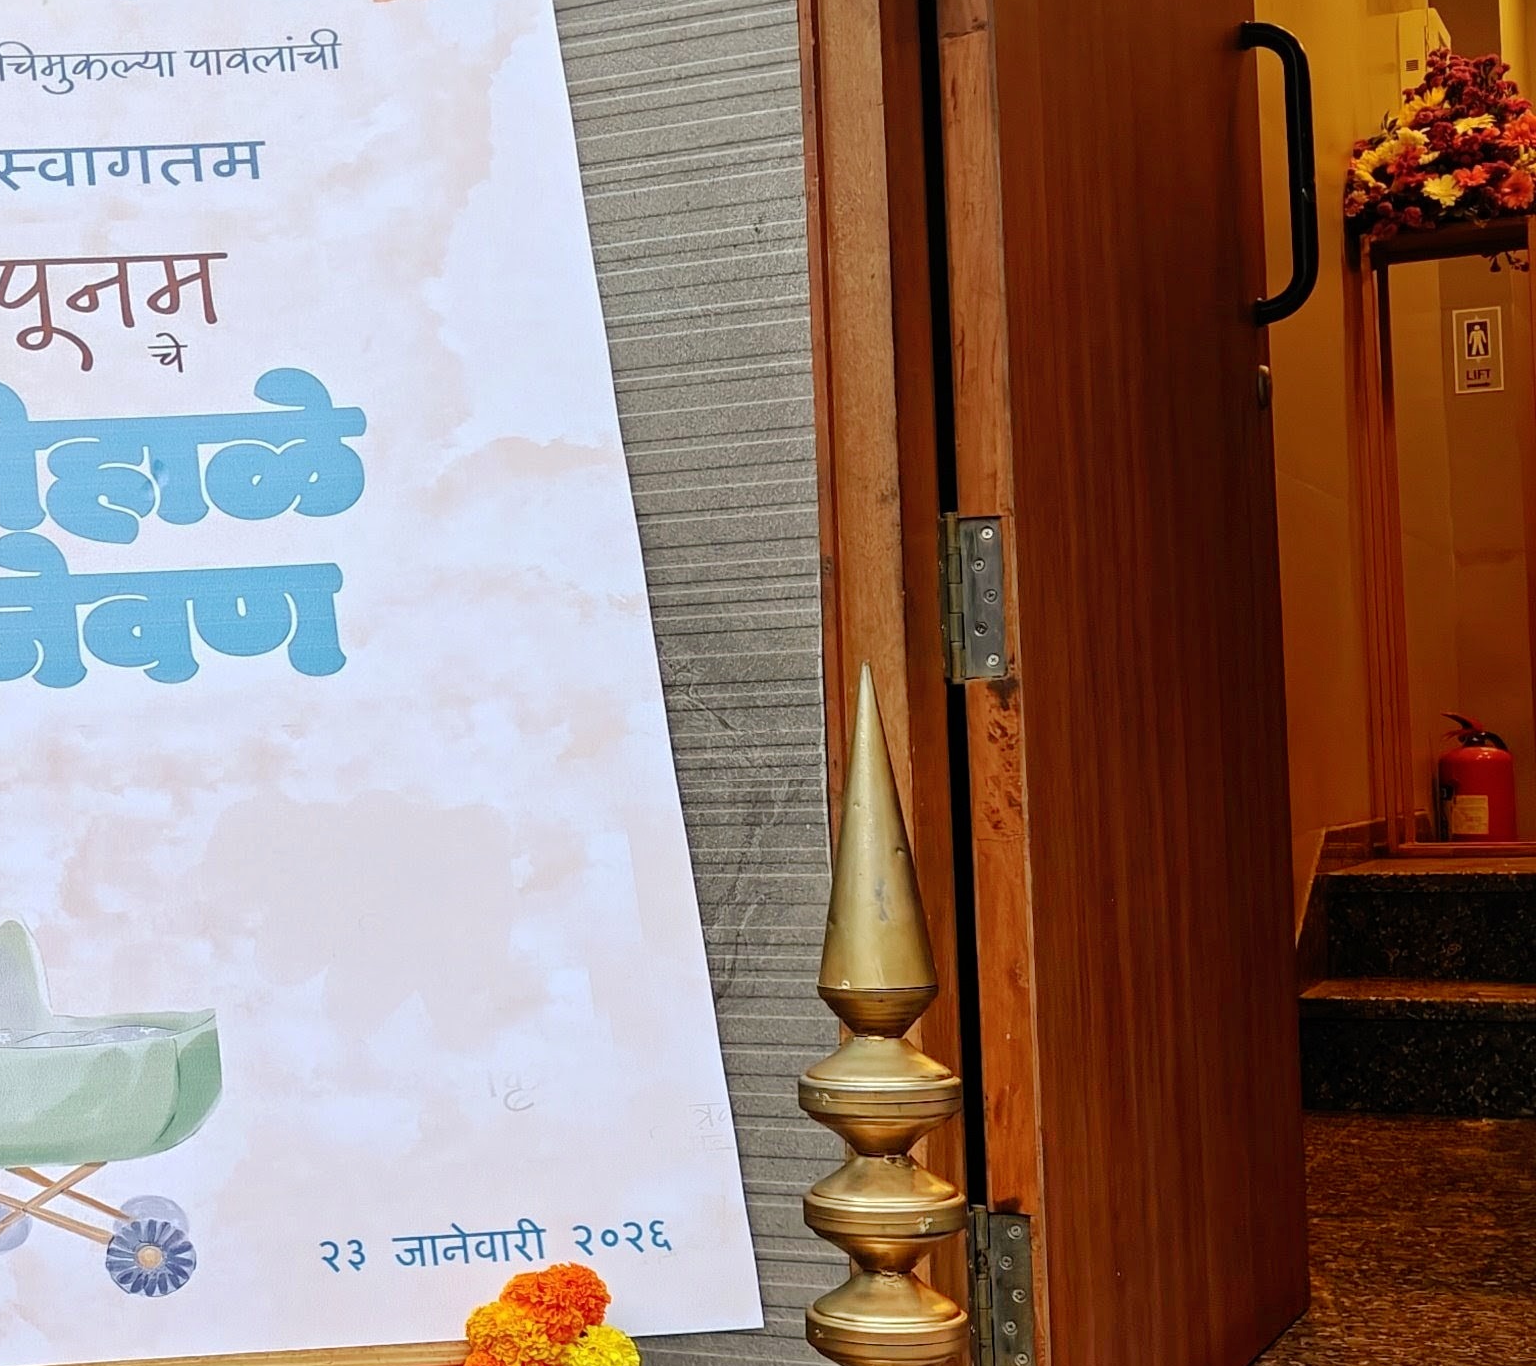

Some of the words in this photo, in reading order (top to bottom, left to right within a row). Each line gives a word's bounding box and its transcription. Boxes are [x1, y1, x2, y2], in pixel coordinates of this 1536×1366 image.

[184, 28, 343, 77] पावलांची
[147, 332, 188, 373] चे
[1466, 368, 1492, 381] LIFT
[319, 1238, 366, 1273] २३
[392, 1217, 547, 1268] जानेवारी
[572, 1219, 673, 1257] २०२६
